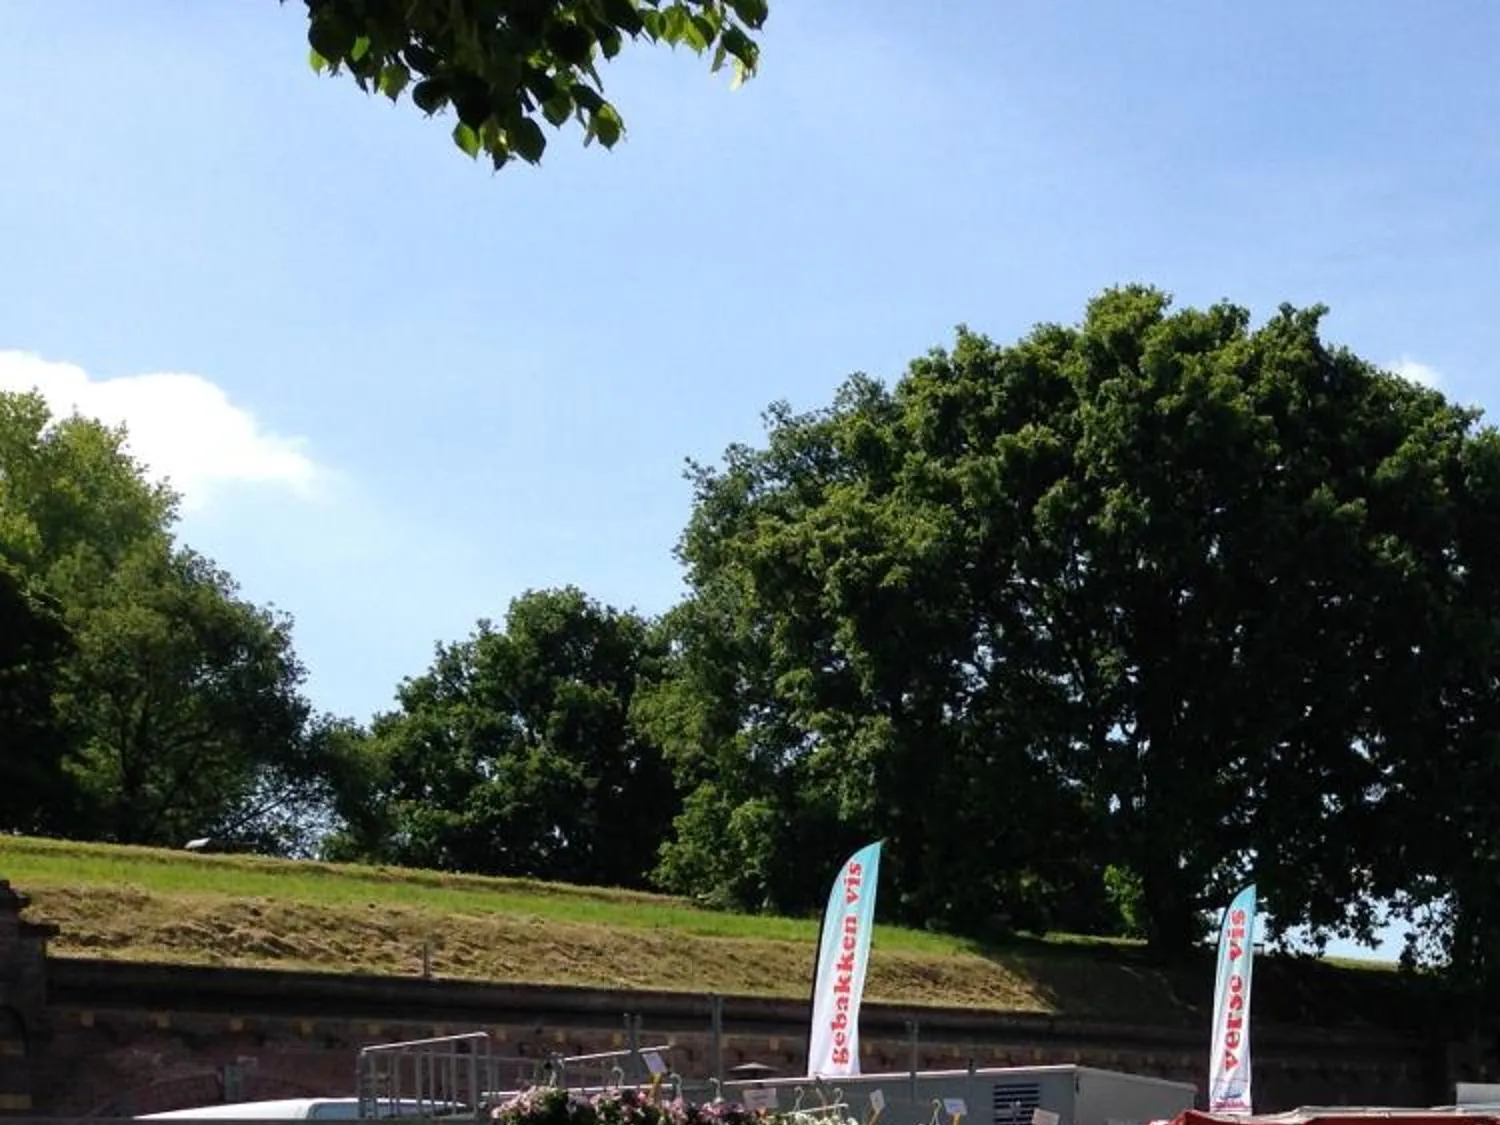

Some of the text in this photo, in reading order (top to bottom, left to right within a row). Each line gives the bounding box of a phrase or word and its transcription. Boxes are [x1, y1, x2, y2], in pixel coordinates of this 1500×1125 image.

[831, 862, 862, 1066] gebakken vis
[1223, 909, 1246, 1071] verse vis
